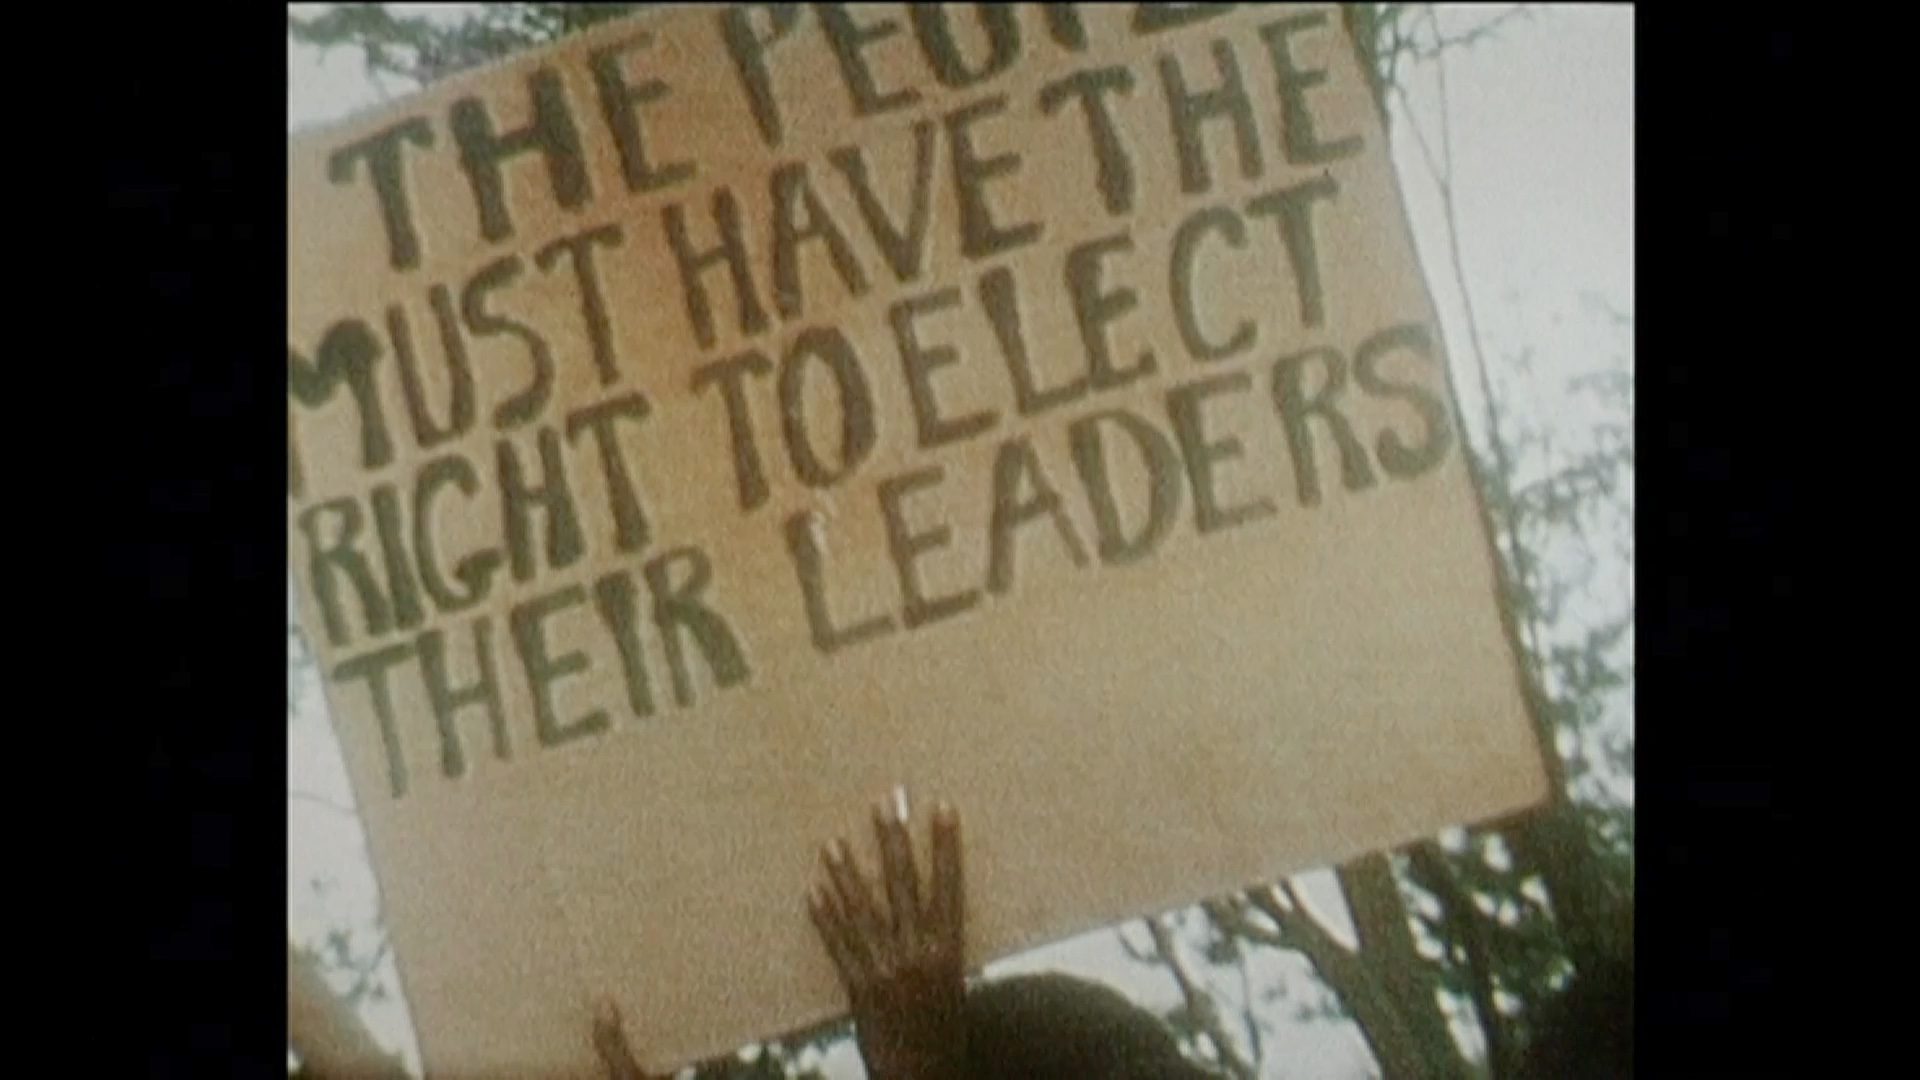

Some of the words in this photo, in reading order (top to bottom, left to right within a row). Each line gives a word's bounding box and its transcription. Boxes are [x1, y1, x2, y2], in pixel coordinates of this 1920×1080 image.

[288, 222, 624, 494] MUST
[662, 99, 1044, 347] HAVE
[1038, 12, 1364, 216] THE
[328, 32, 697, 270] THE
[717, 4, 1236, 146] PEO
[299, 390, 651, 646] RIGHT
[691, 325, 878, 511] TO
[889, 176, 1340, 449] ELECT
[332, 543, 751, 799] THEIR
[784, 323, 1453, 654] LEADERS
